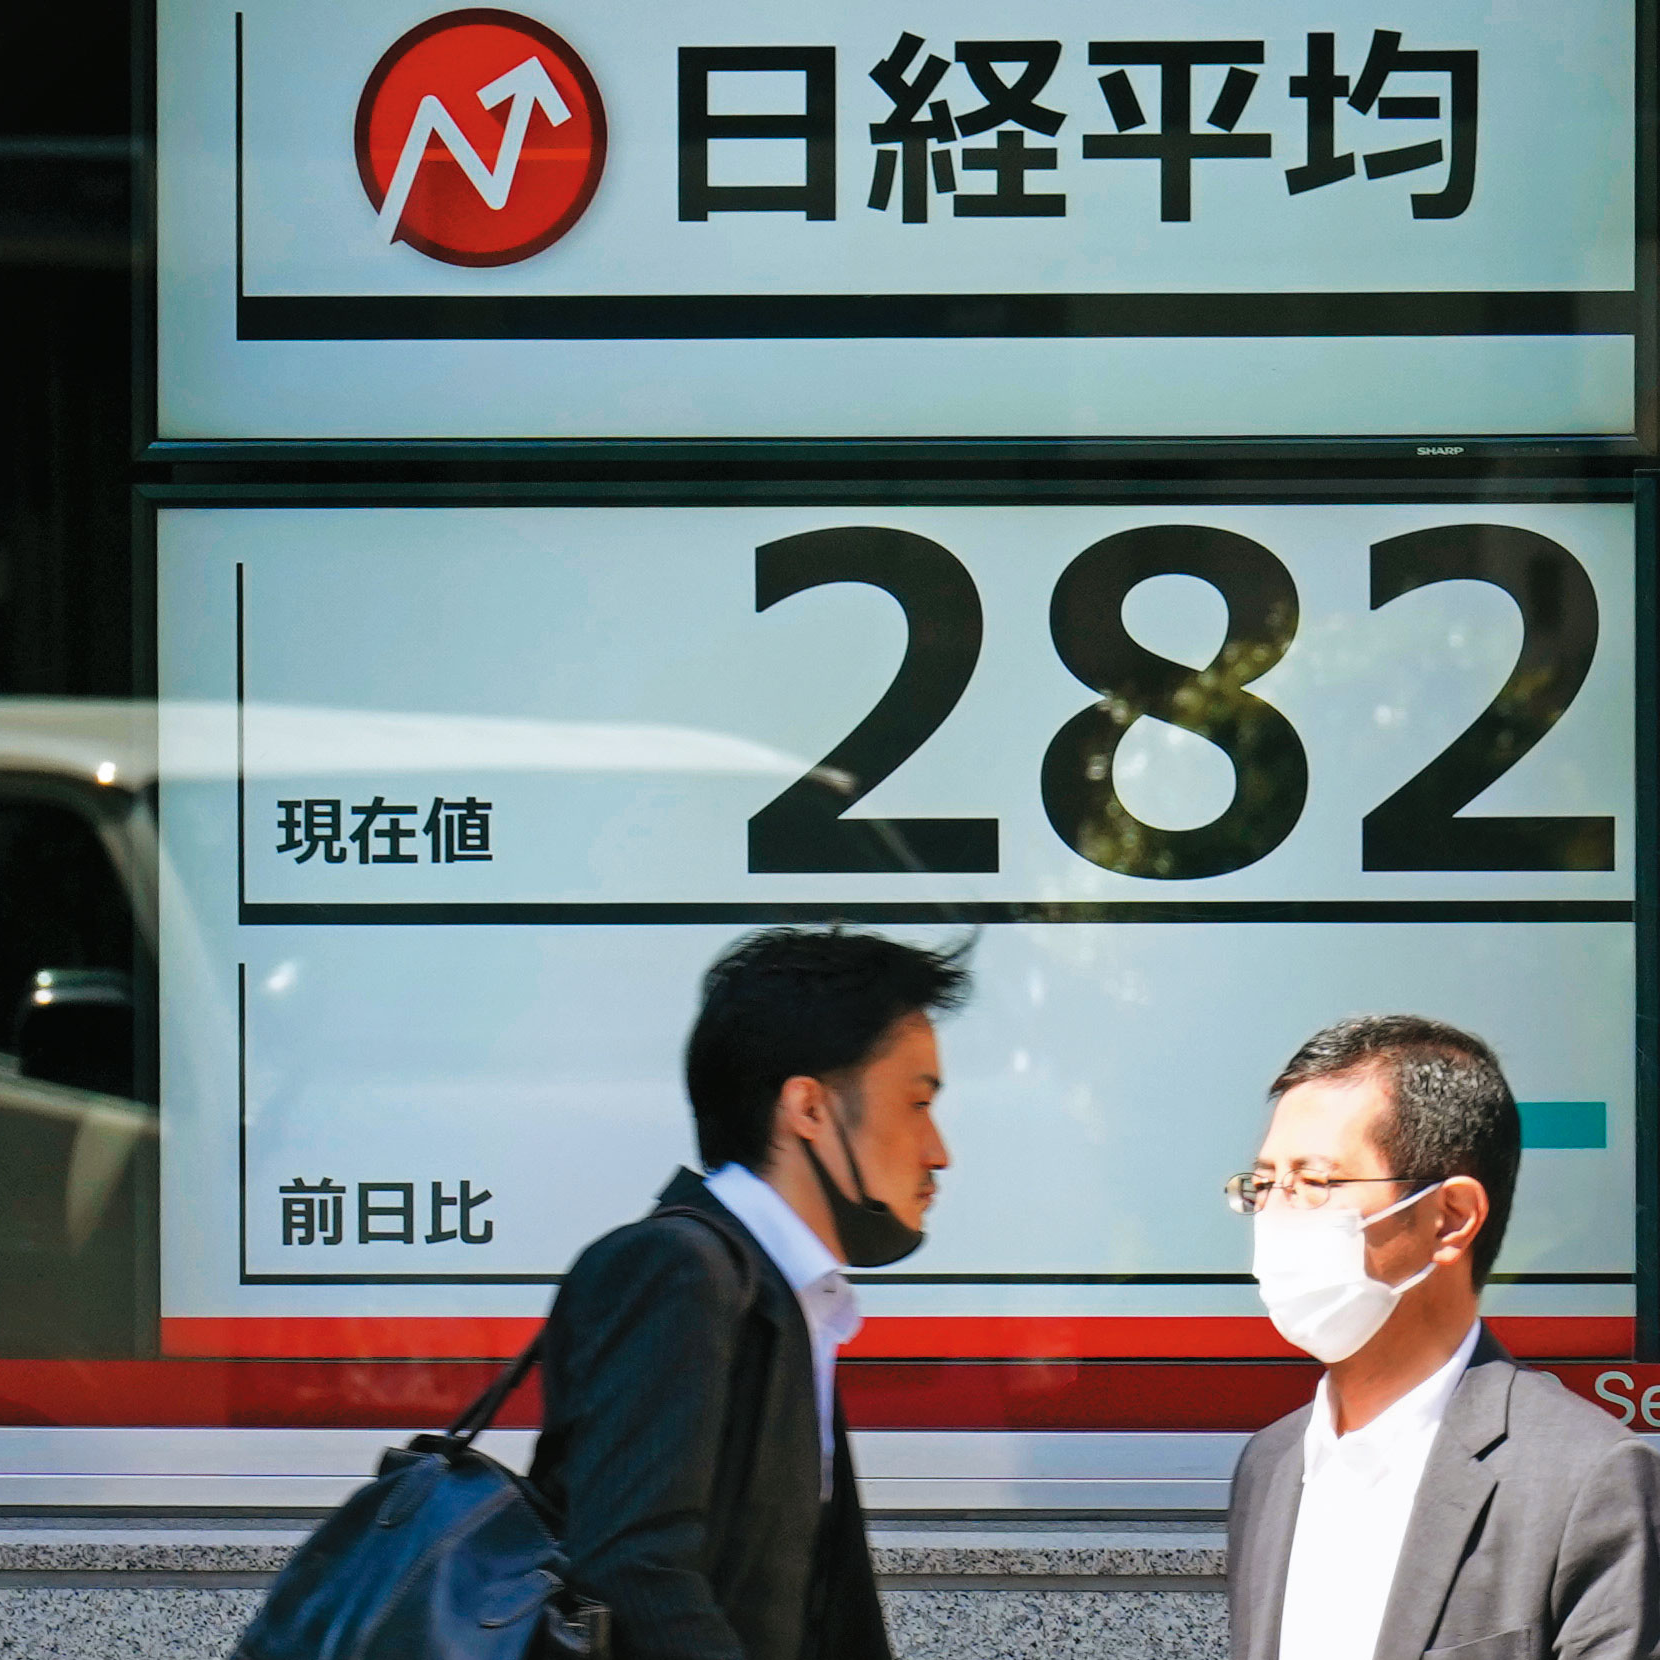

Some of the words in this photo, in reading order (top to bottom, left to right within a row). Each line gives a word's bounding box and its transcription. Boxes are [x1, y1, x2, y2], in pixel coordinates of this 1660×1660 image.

[676, 29, 1479, 225] 日経平均
[1416, 447, 1465, 456] SHARP
[275, 795, 494, 866] 現在値
[278, 1176, 494, 1247] 前日比
